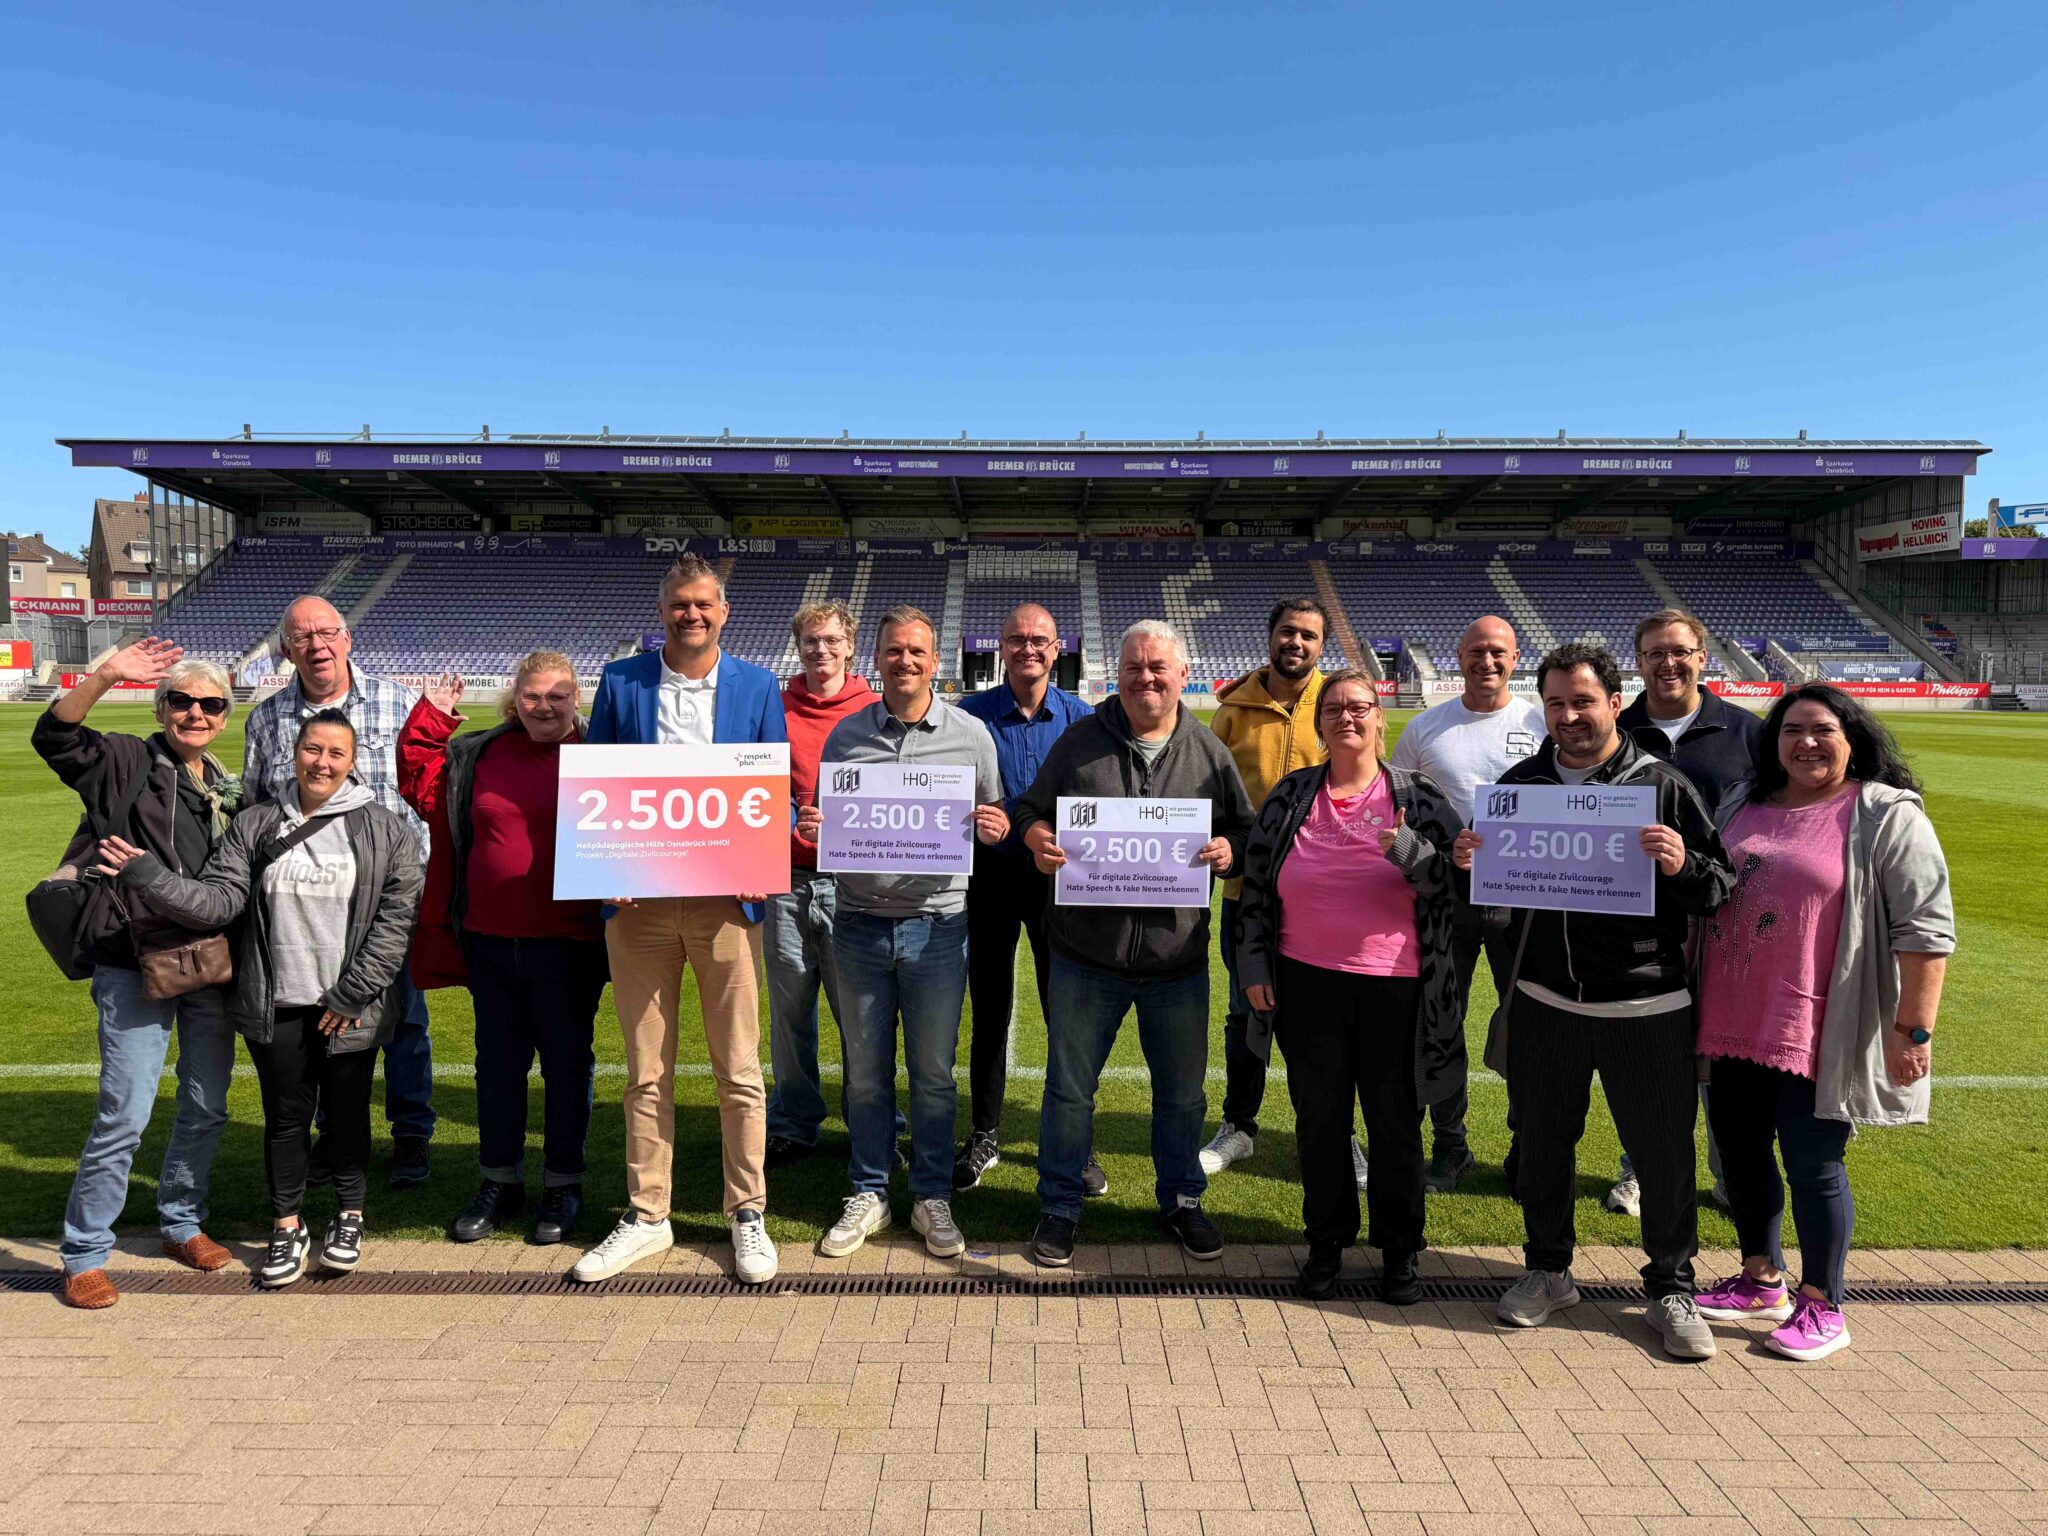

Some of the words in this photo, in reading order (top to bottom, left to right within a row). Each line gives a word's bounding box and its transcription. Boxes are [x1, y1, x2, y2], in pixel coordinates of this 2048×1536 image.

[393, 454, 430, 464] BREMER
[445, 452, 482, 464] BRÜCKE
[623, 456, 660, 466] BREMER
[675, 455, 712, 466] BRÜCKE
[1351, 460, 1389, 470] BREMER
[1404, 457, 1442, 469] BRÜCKE
[1583, 459, 1620, 469] BREMER
[1636, 457, 1672, 469] BRÜCKE
[987, 461, 1024, 470] BREMER
[1039, 459, 1076, 471] BRÜCKE
[382, 516, 470, 529] STROHBECKE
[676, 517, 713, 528] SCHUBERT
[782, 519, 841, 527] LOGISTIK
[1736, 520, 1784, 528] Immobilien
[1911, 516, 1946, 531] HOVING
[645, 538, 689, 552] DSV
[718, 539, 748, 552] L&S
[1903, 532, 1948, 548] HELLMICH
[1416, 543, 1454, 553] KOCH
[1498, 543, 1536, 553] KOCH
[11, 601, 80, 611] ECKMANN
[98, 602, 151, 612] DIECKMA
[1801, 640, 1824, 648] KINDER
[1832, 640, 1857, 648] TRIBÜNE
[1875, 665, 1901, 674] TRIBÜNE
[1723, 682, 1772, 696] Philipps
[1931, 683, 1979, 696] Philipps
[744, 753, 772, 761] respekt
[833, 768, 861, 794] VFL
[576, 787, 728, 831] 2.500
[737, 787, 772, 828] €
[1487, 789, 1519, 819] VFL
[842, 803, 925, 830] 2.500
[934, 805, 951, 830] €
[1070, 802, 1098, 828] VFL
[576, 841, 644, 850] Heilpädagogische
[708, 839, 730, 847] (HHO)
[851, 839, 863, 847] Für
[865, 840, 894, 849] digitale
[895, 840, 941, 849] Zivilcourage
[1497, 828, 1593, 861] 2.500
[1605, 833, 1625, 862] €
[576, 851, 604, 860] Projekt
[849, 851, 876, 860] Speech
[905, 852, 925, 860] News
[927, 853, 963, 861] erkennen
[1080, 837, 1162, 863] 2.500
[1171, 839, 1187, 864] €
[1102, 873, 1131, 882] digitale
[1133, 874, 1178, 883] Zivilcourage
[1507, 870, 1521, 878] Für
[1523, 870, 1557, 881] digitale
[1559, 871, 1614, 884] Zivilcourage
[1085, 884, 1113, 893] Speech
[1142, 885, 1162, 893] News
[1483, 881, 1503, 890] Hate
[1504, 882, 1536, 893] Speech
[1538, 884, 1546, 892] &
[1548, 885, 1568, 894] Fake
[1570, 886, 1595, 896] News
[1597, 888, 1641, 898] erkennen
